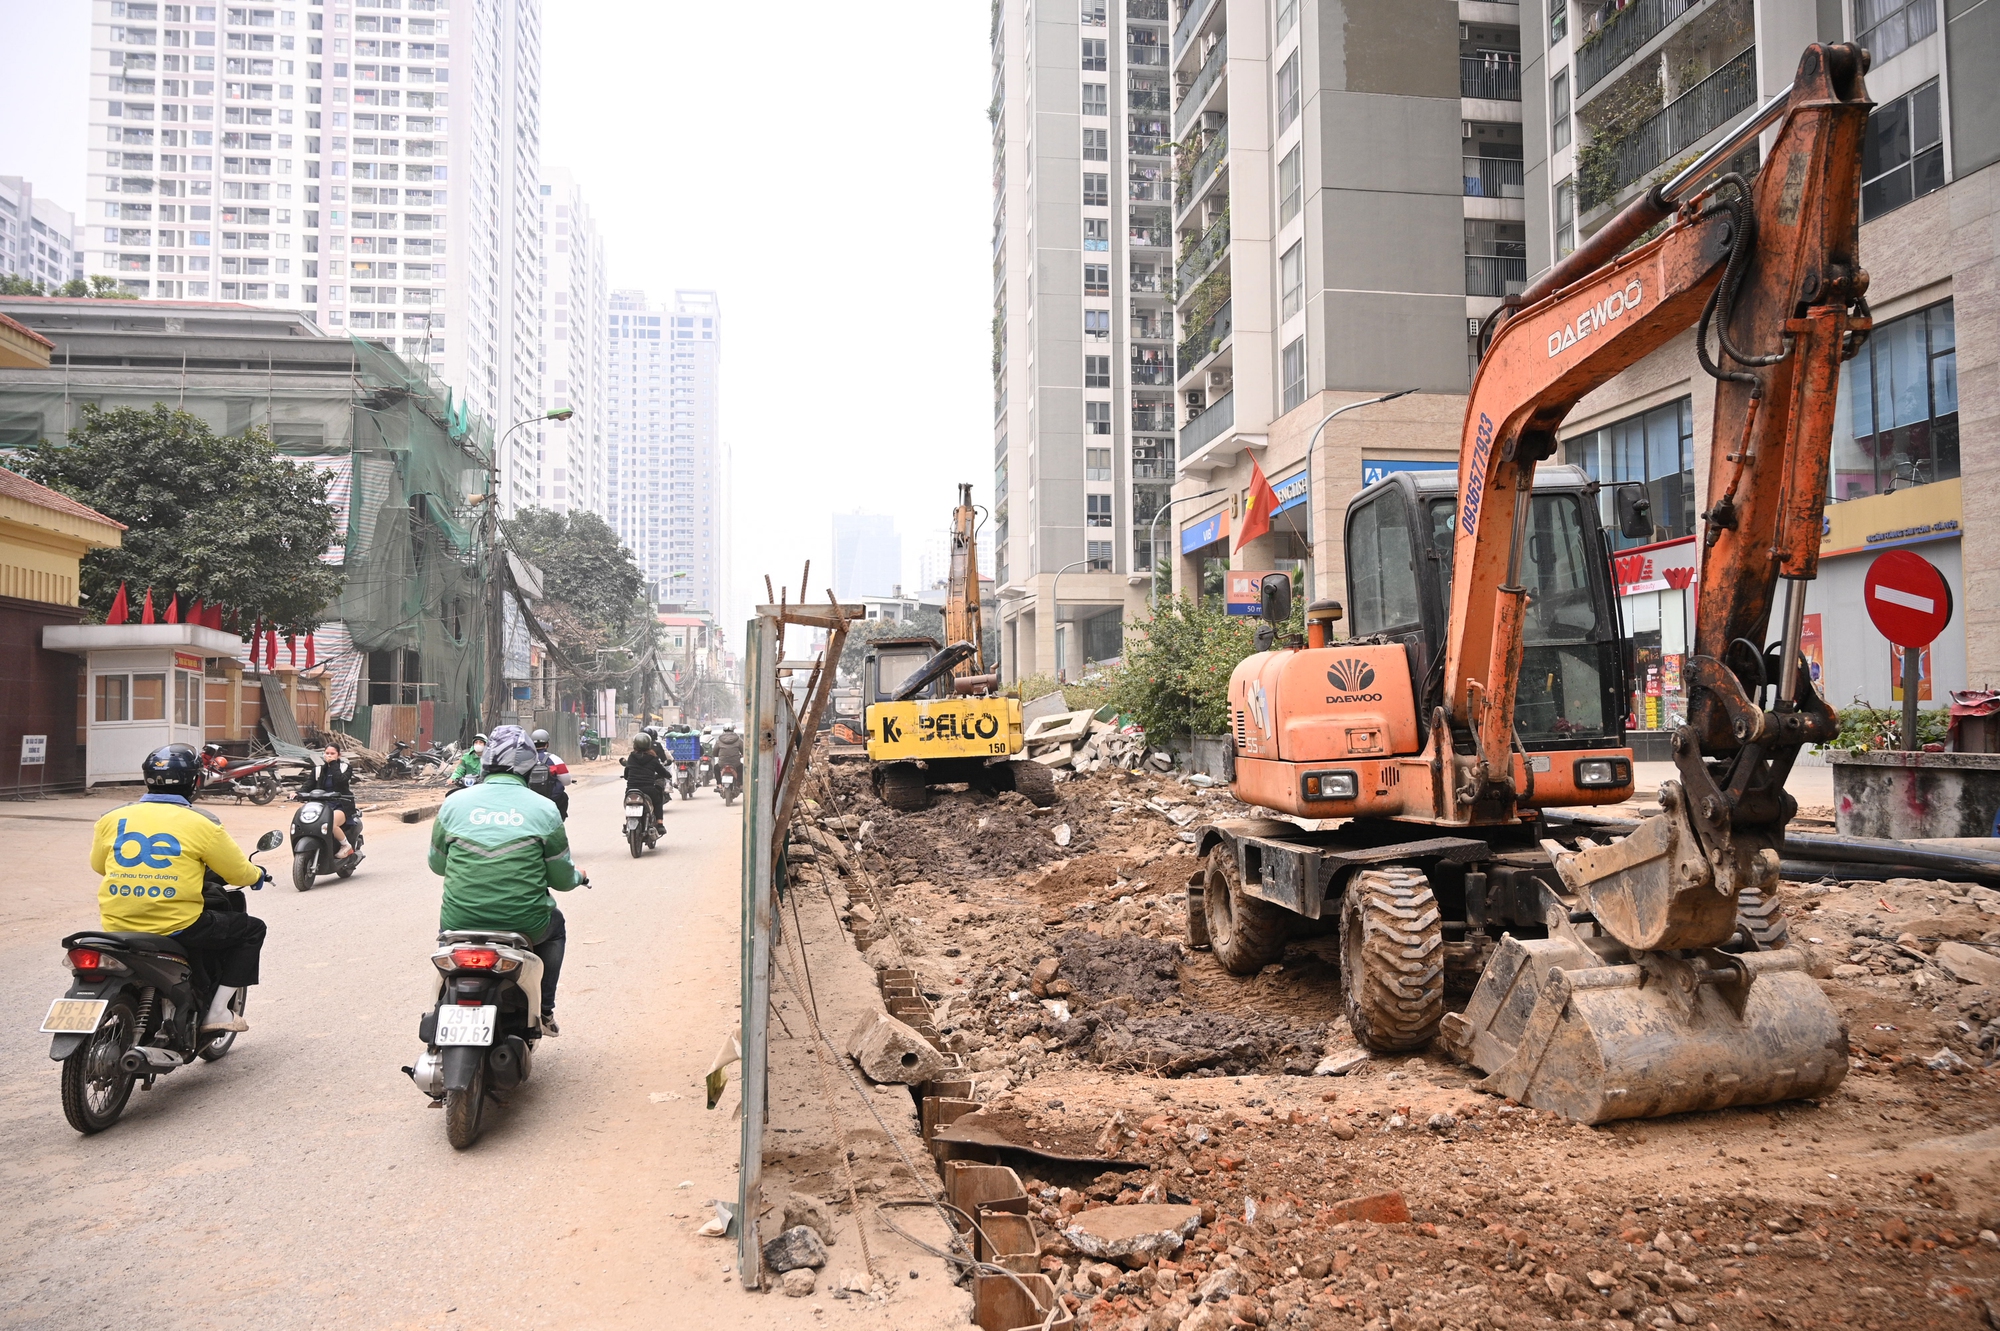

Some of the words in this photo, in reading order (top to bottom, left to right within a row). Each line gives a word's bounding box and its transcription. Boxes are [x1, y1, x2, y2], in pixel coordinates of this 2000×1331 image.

[1547, 279, 1642, 358] DAEWOO
[1462, 412, 1493, 535] 0936577933
[1202, 529, 1212, 542] VIB
[1326, 693, 1382, 704] DAEWOO
[989, 743, 1006, 754] 150
[469, 807, 524, 827] Grab
[113, 818, 182, 869] be
[58, 1002, 97, 1015] 18-L1
[440, 1026, 490, 1043] 997.62
